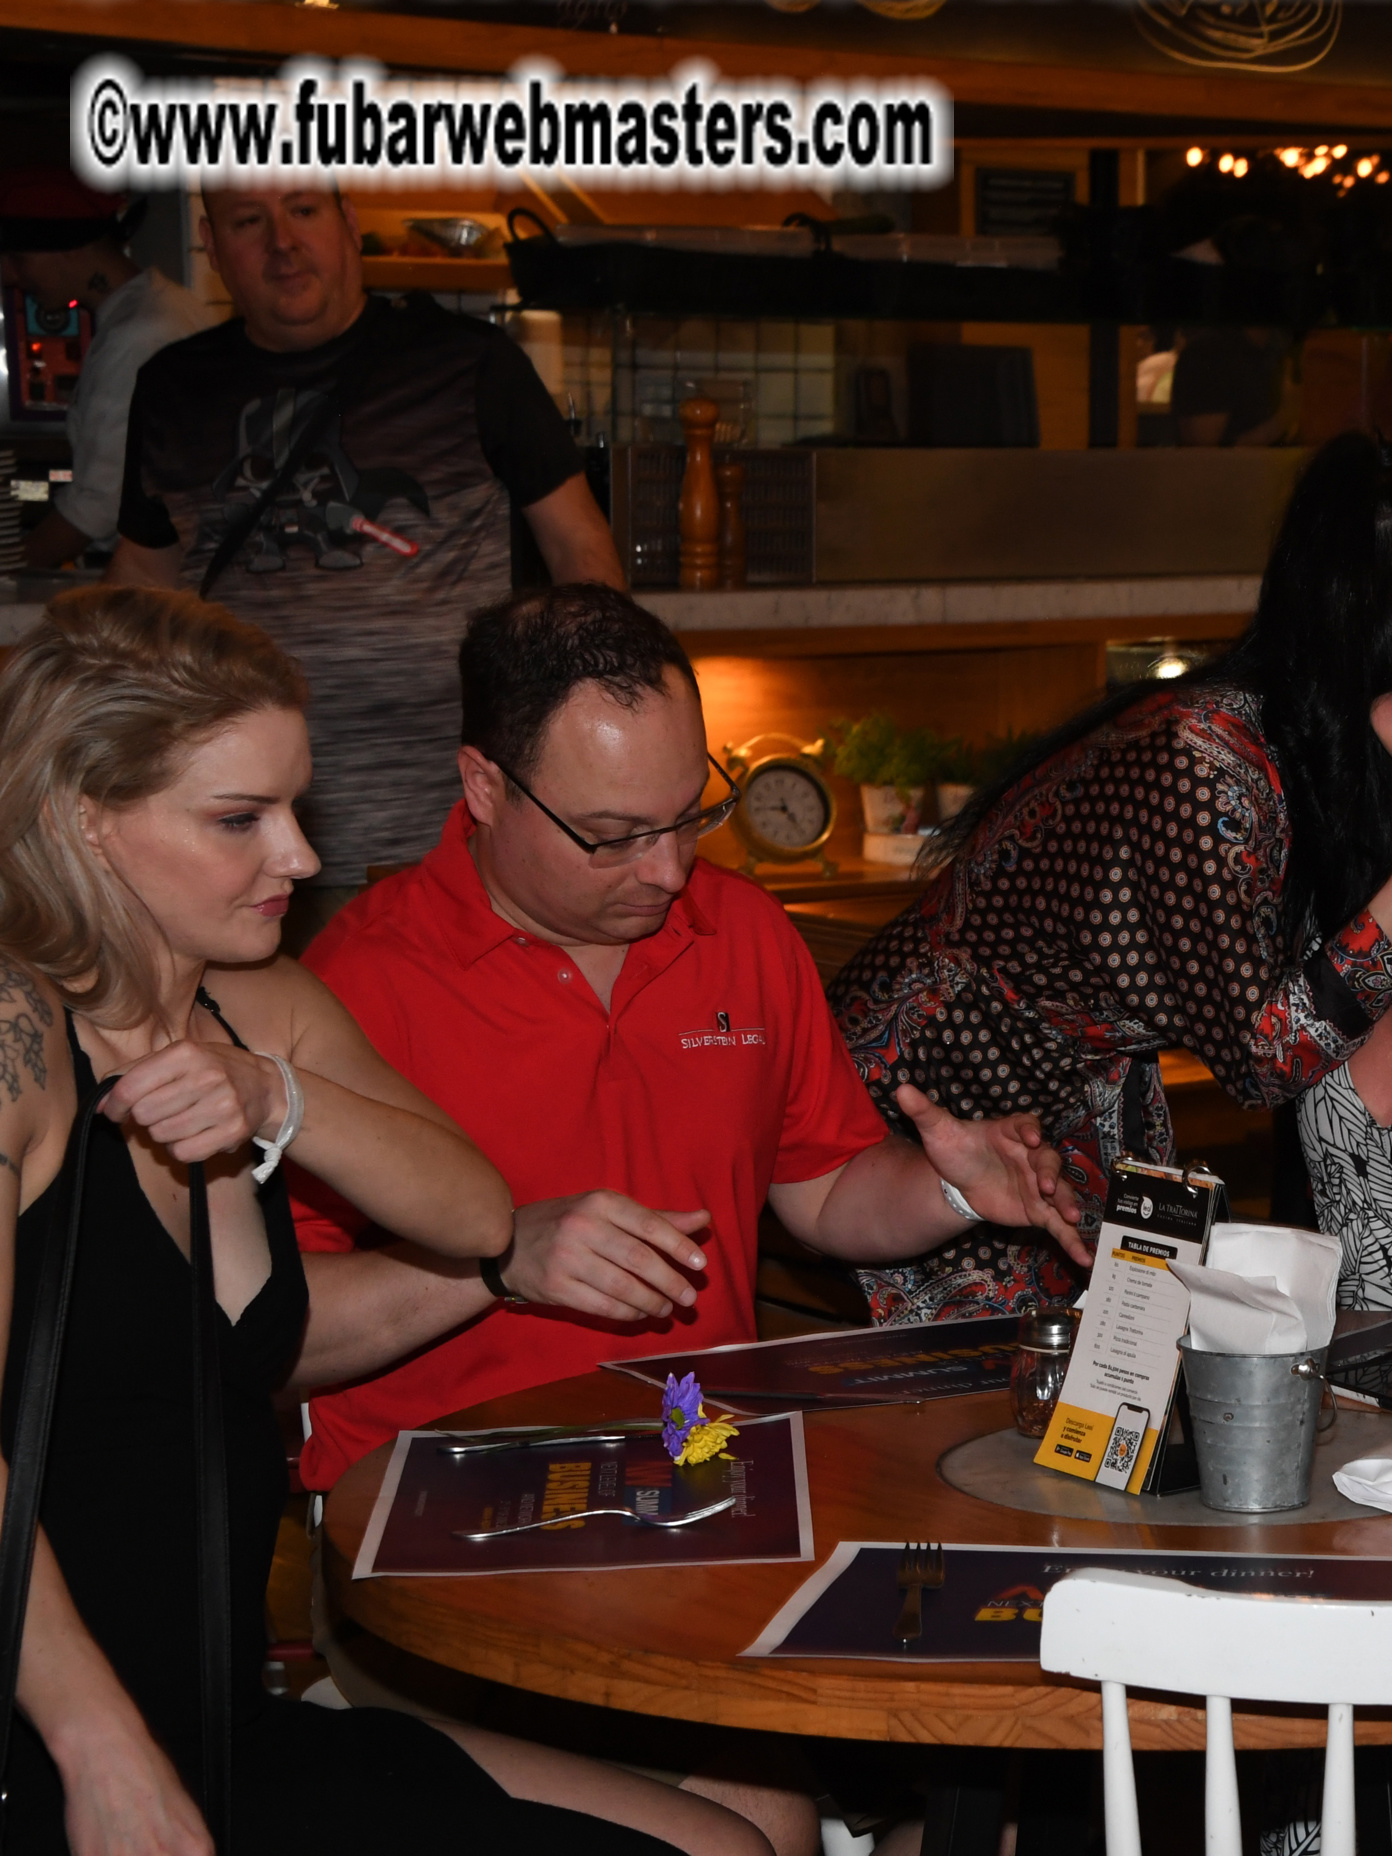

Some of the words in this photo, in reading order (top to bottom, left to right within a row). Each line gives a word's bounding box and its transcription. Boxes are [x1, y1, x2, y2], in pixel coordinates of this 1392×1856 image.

[1116, 1204, 1137, 1215] premios
[1128, 1241, 1143, 1250] TABLA
[1149, 1247, 1170, 1257] PREMIOS
[808, 1342, 1019, 1375] USINESS
[540, 1462, 592, 1531] BUSINESS
[1210, 1568, 1315, 1579] dinner!
